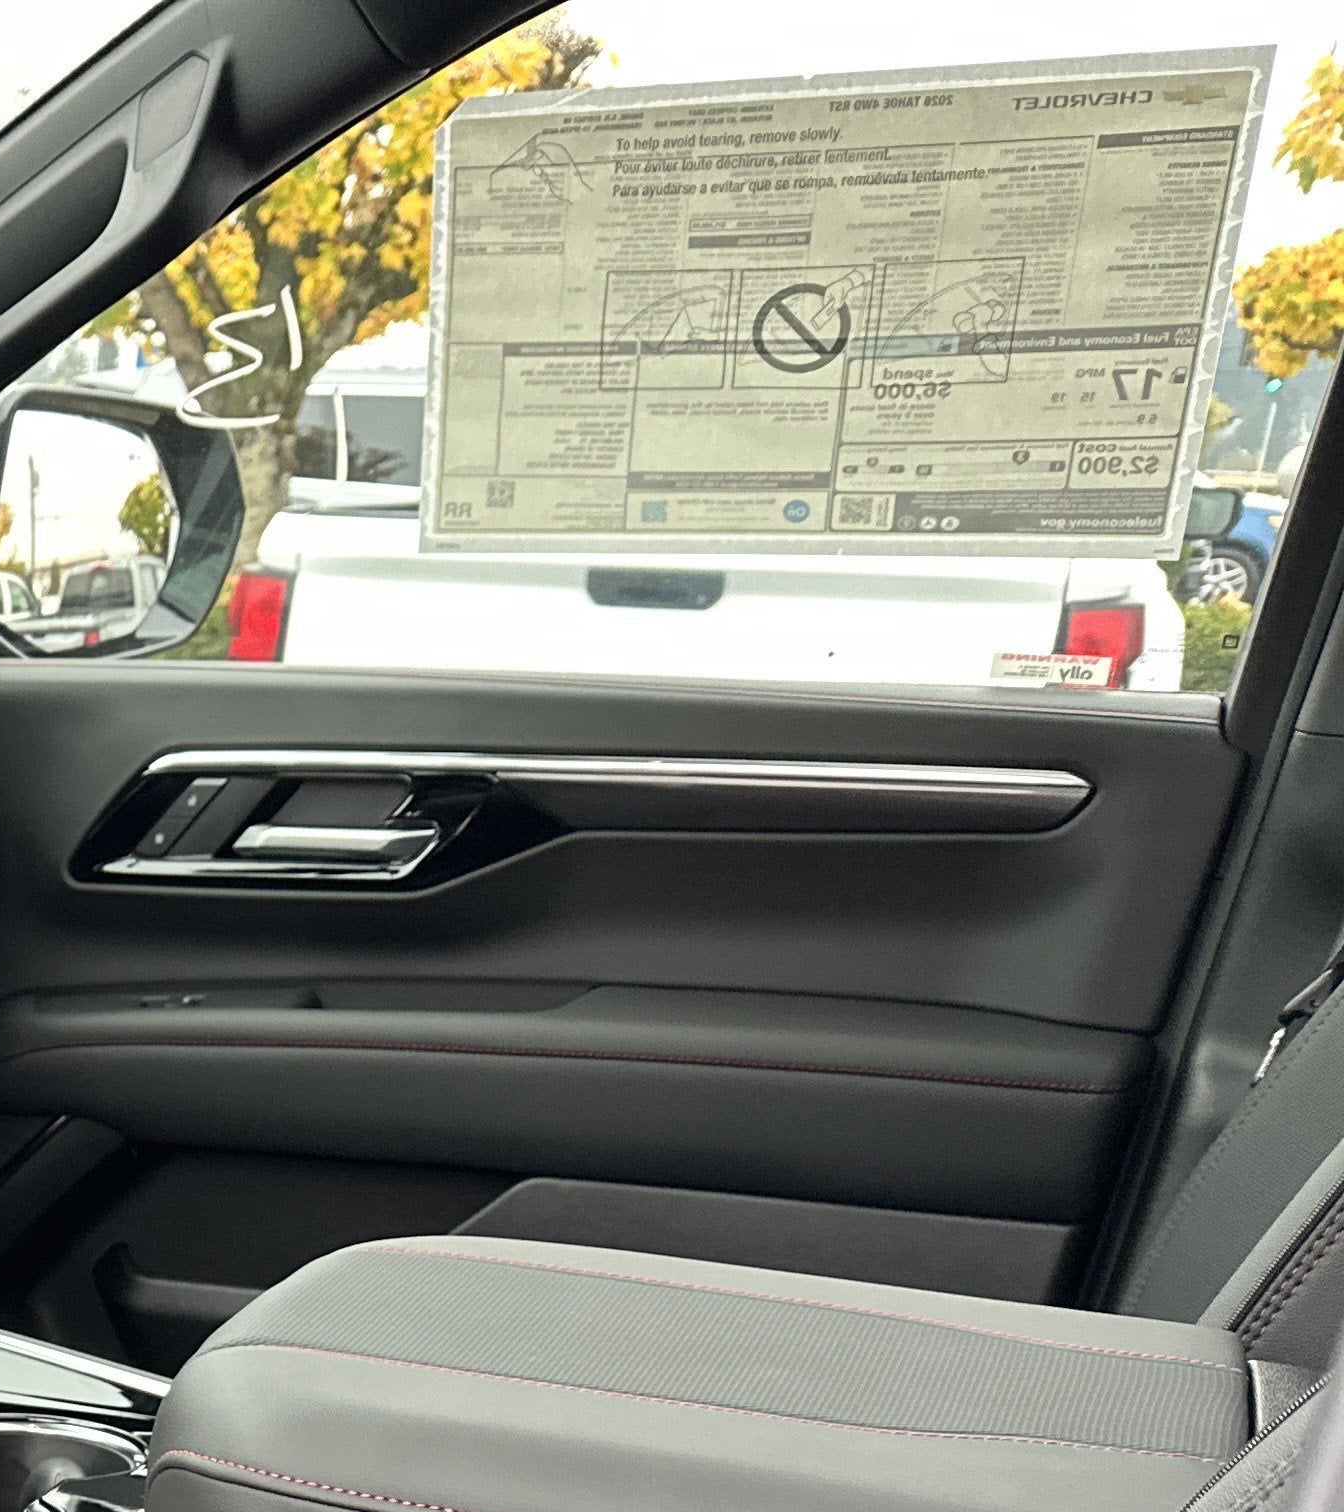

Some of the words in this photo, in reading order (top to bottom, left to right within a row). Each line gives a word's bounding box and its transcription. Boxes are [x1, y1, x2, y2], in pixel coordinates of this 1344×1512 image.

[616, 137, 631, 151] To
[633, 135, 659, 153] help
[662, 132, 696, 149] avoid
[699, 130, 745, 149] tearing,
[749, 129, 796, 145] remove
[799, 126, 844, 144] slowly.
[614, 157, 642, 175] Pour
[643, 156, 678, 174] éviter
[681, 154, 713, 172] toute
[715, 152, 778, 170] déchirure,
[781, 151, 821, 167] retirer
[824, 147, 892, 165] lentement.
[612, 183, 639, 198] Para
[641, 179, 697, 199] ayudarse
[699, 182, 708, 195] a
[710, 177, 746, 195] evitar
[748, 178, 772, 195] que
[774, 179, 790, 192] se
[793, 174, 838, 191] rompa,
